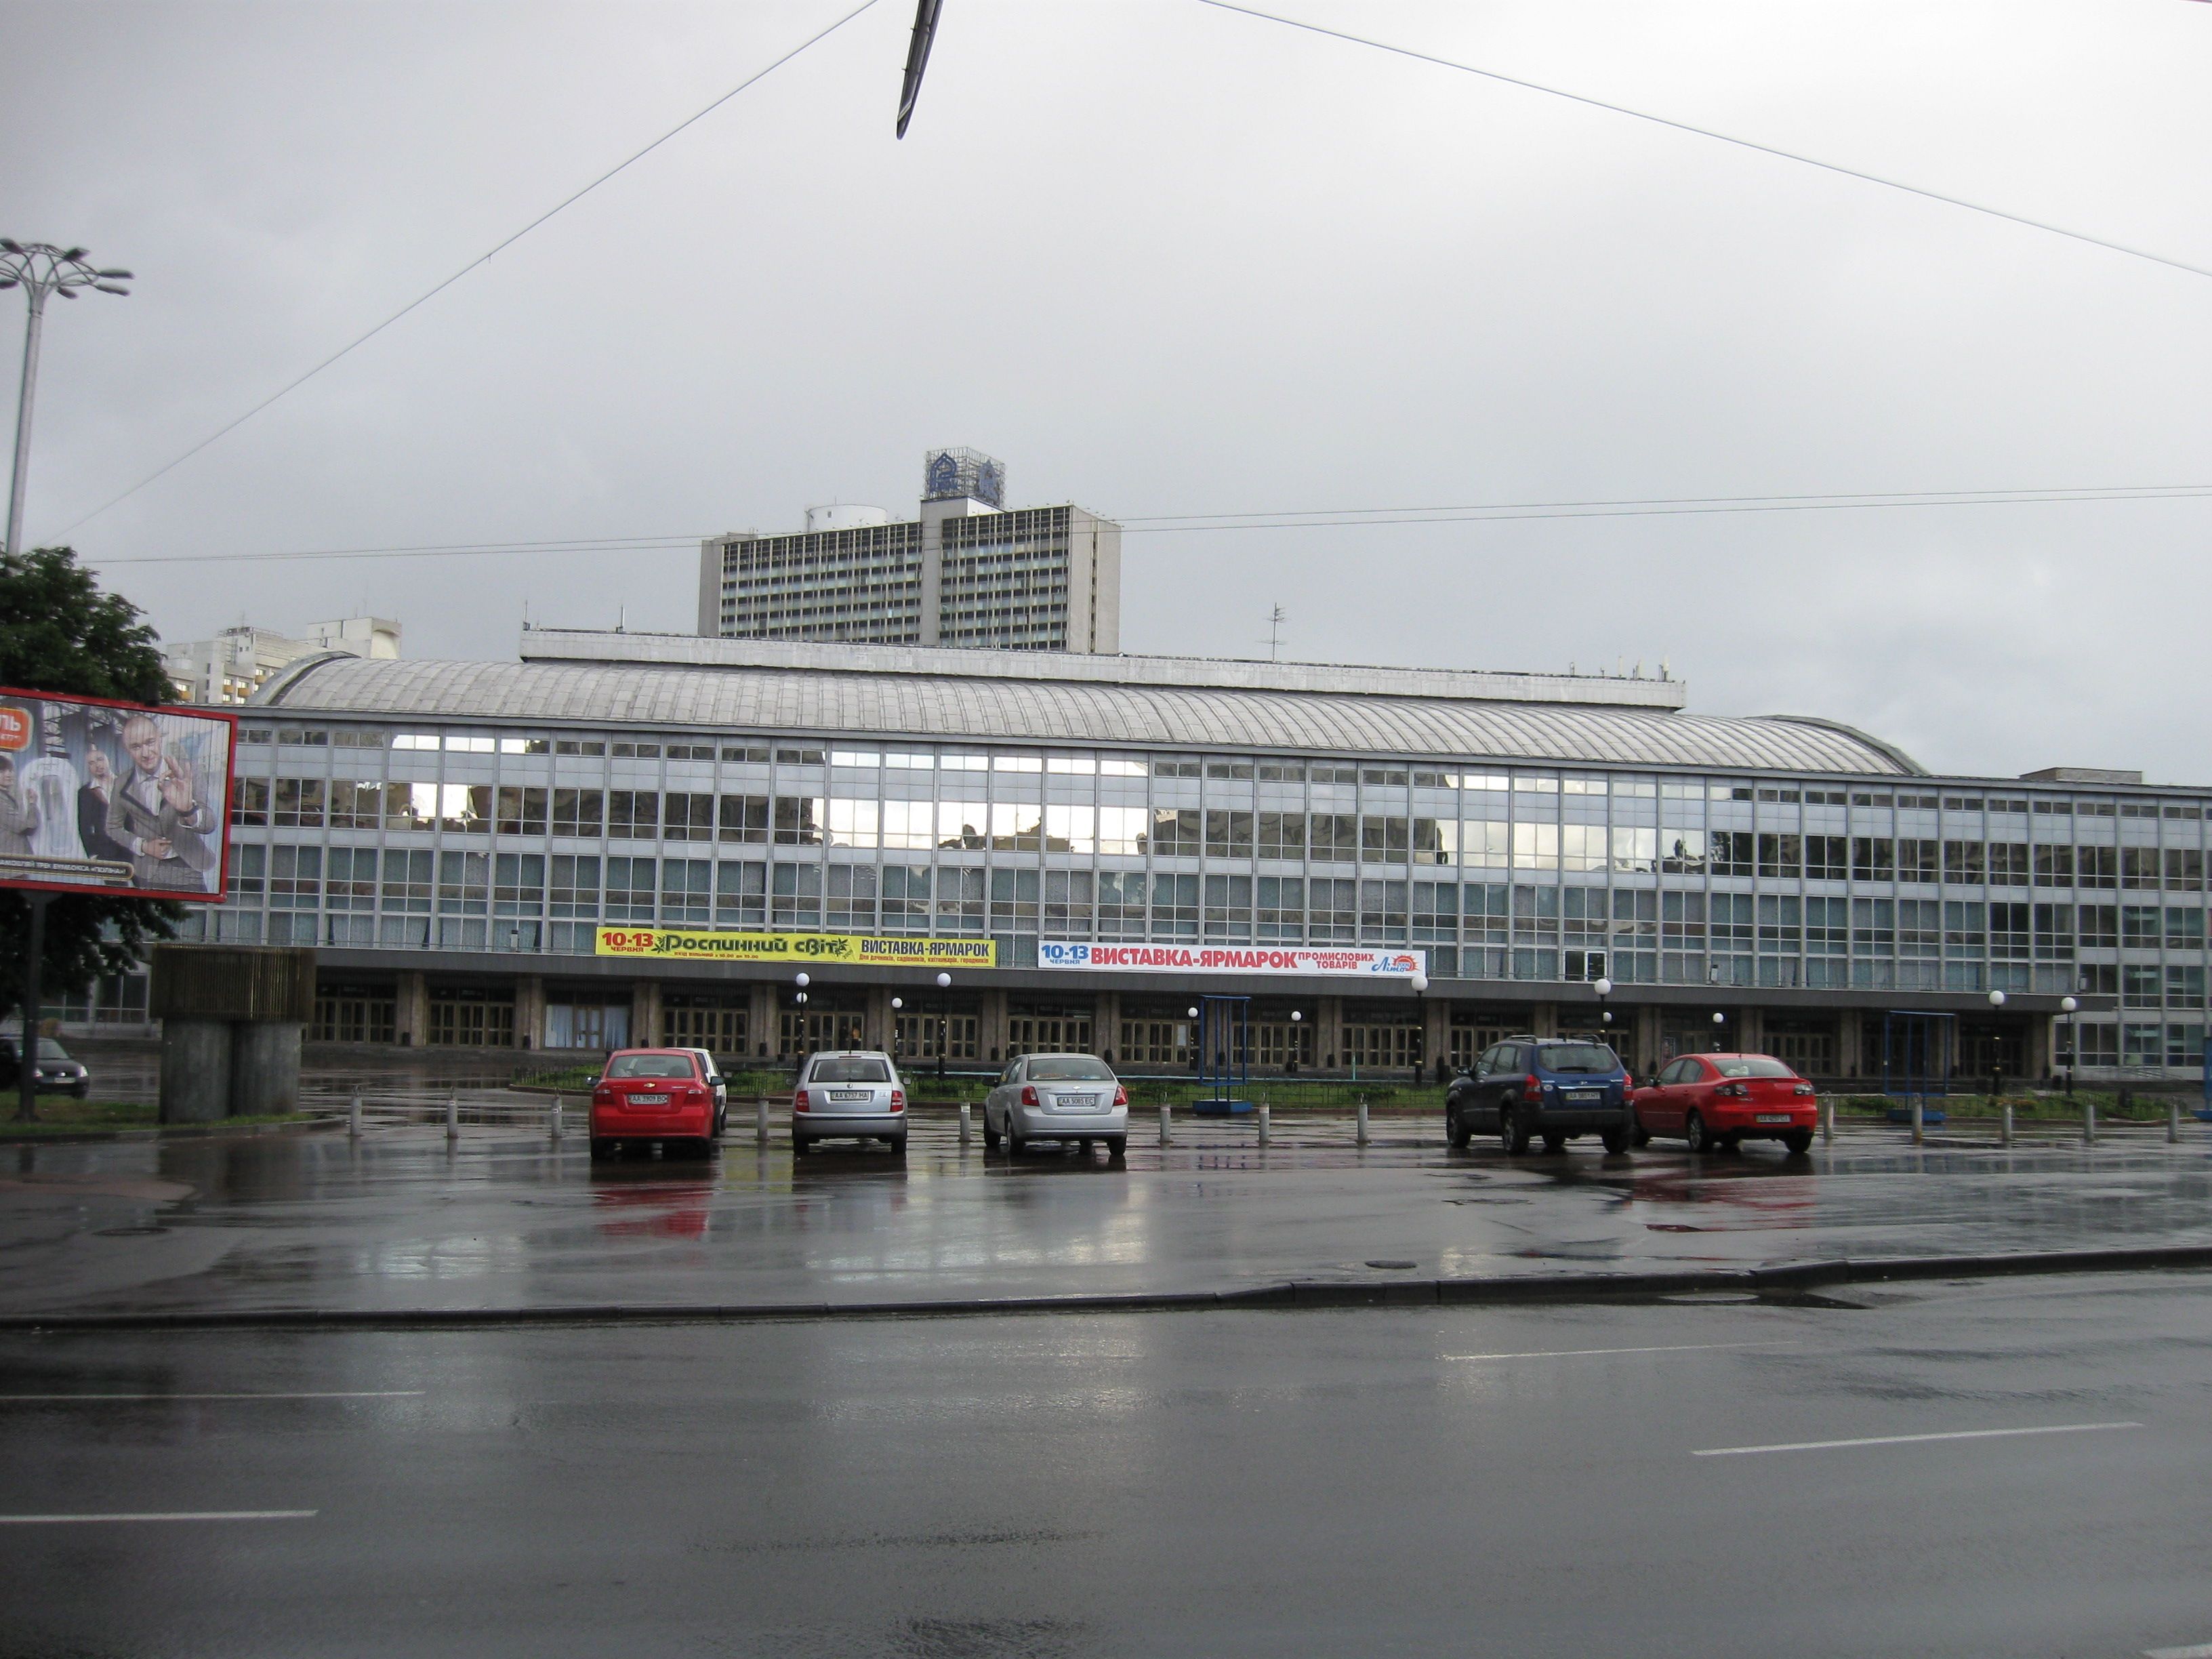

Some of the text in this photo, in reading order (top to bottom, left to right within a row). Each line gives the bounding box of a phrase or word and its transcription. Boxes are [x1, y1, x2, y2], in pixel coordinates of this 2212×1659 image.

[602, 932, 653, 947] 10-13
[861, 939, 989, 956] ВИСТАВКА-ЯРМАРОК
[1042, 945, 1089, 959] 10-13
[1091, 947, 1298, 968] ВИСТАВКА-ЯРМАРОК
[1298, 951, 1374, 962] ПРОМИСЛОВИХ
[1317, 960, 1357, 970] ТОВАРІВ
